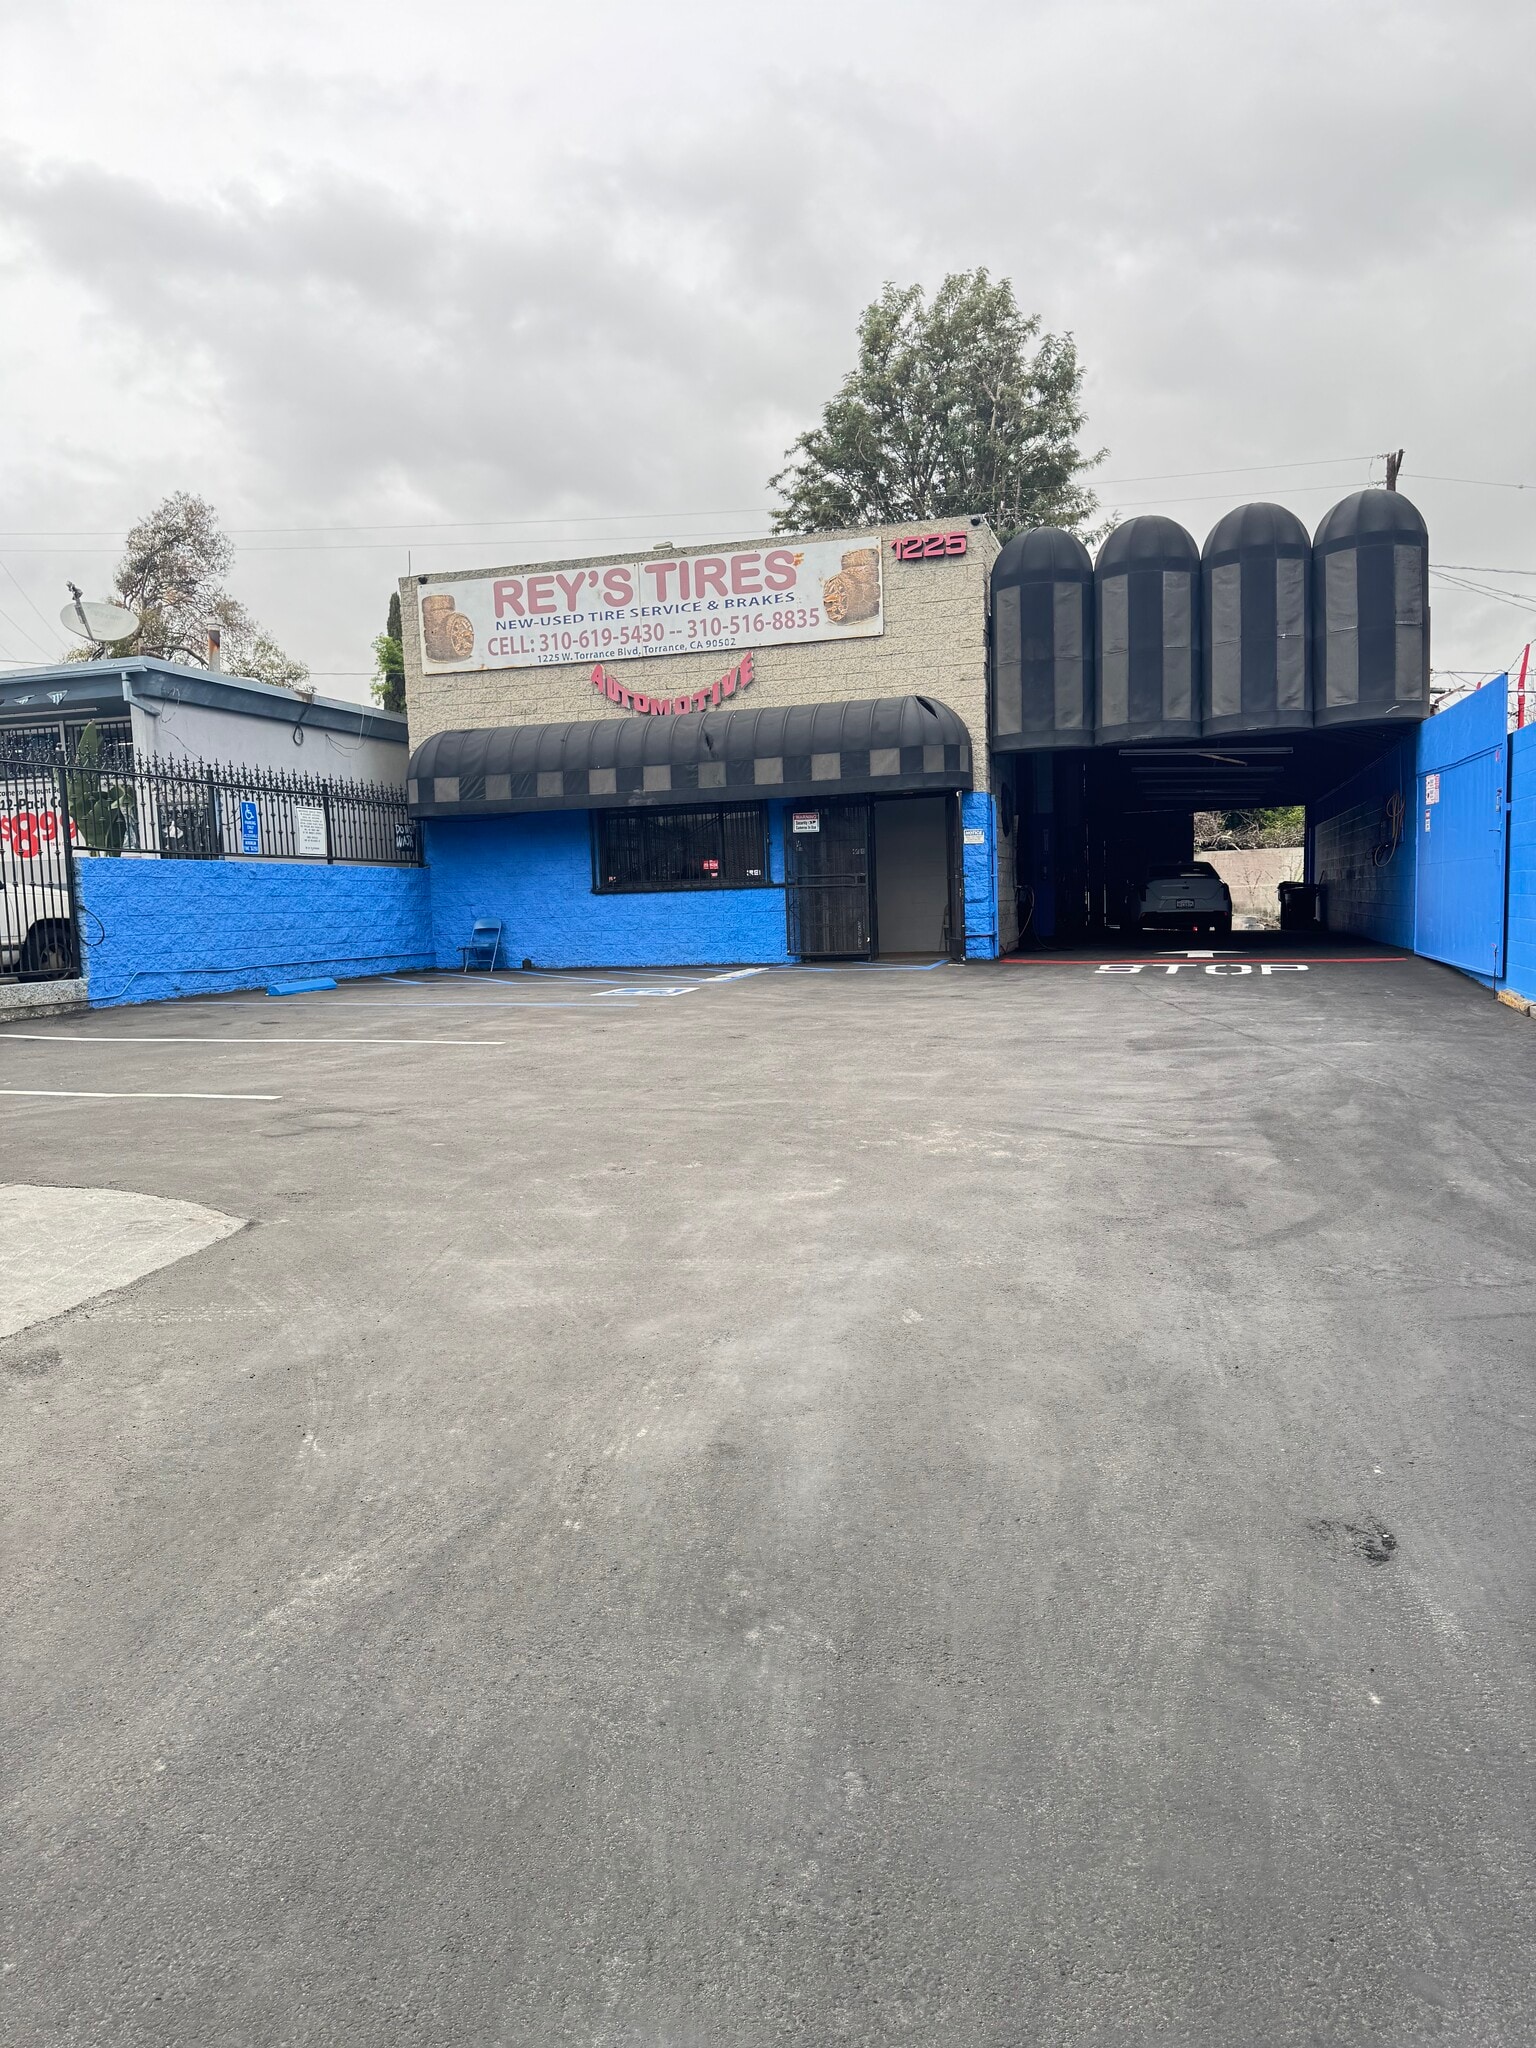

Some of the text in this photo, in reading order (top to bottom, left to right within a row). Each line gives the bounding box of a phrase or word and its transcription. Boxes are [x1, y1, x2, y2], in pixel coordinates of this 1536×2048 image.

[890, 531, 967, 561] 1225
[493, 550, 797, 619] REY'S TIRES
[496, 592, 795, 631] NEW-USED TIRE SERVICE & BRAKES
[487, 635, 535, 656] CELL:
[539, 622, 665, 652] 310-619-5430
[687, 607, 820, 639] 310-516-8835
[537, 653, 560, 663] 1225
[561, 652, 573, 661] W.
[574, 650, 615, 660] Torrance
[643, 644, 688, 655] Torrance,
[690, 641, 703, 650] CA
[706, 638, 736, 648] 90502
[590, 650, 754, 716] AUTOMOTIVE
[395, 824, 404, 834] DO
[1094, 964, 1309, 976] STOP
